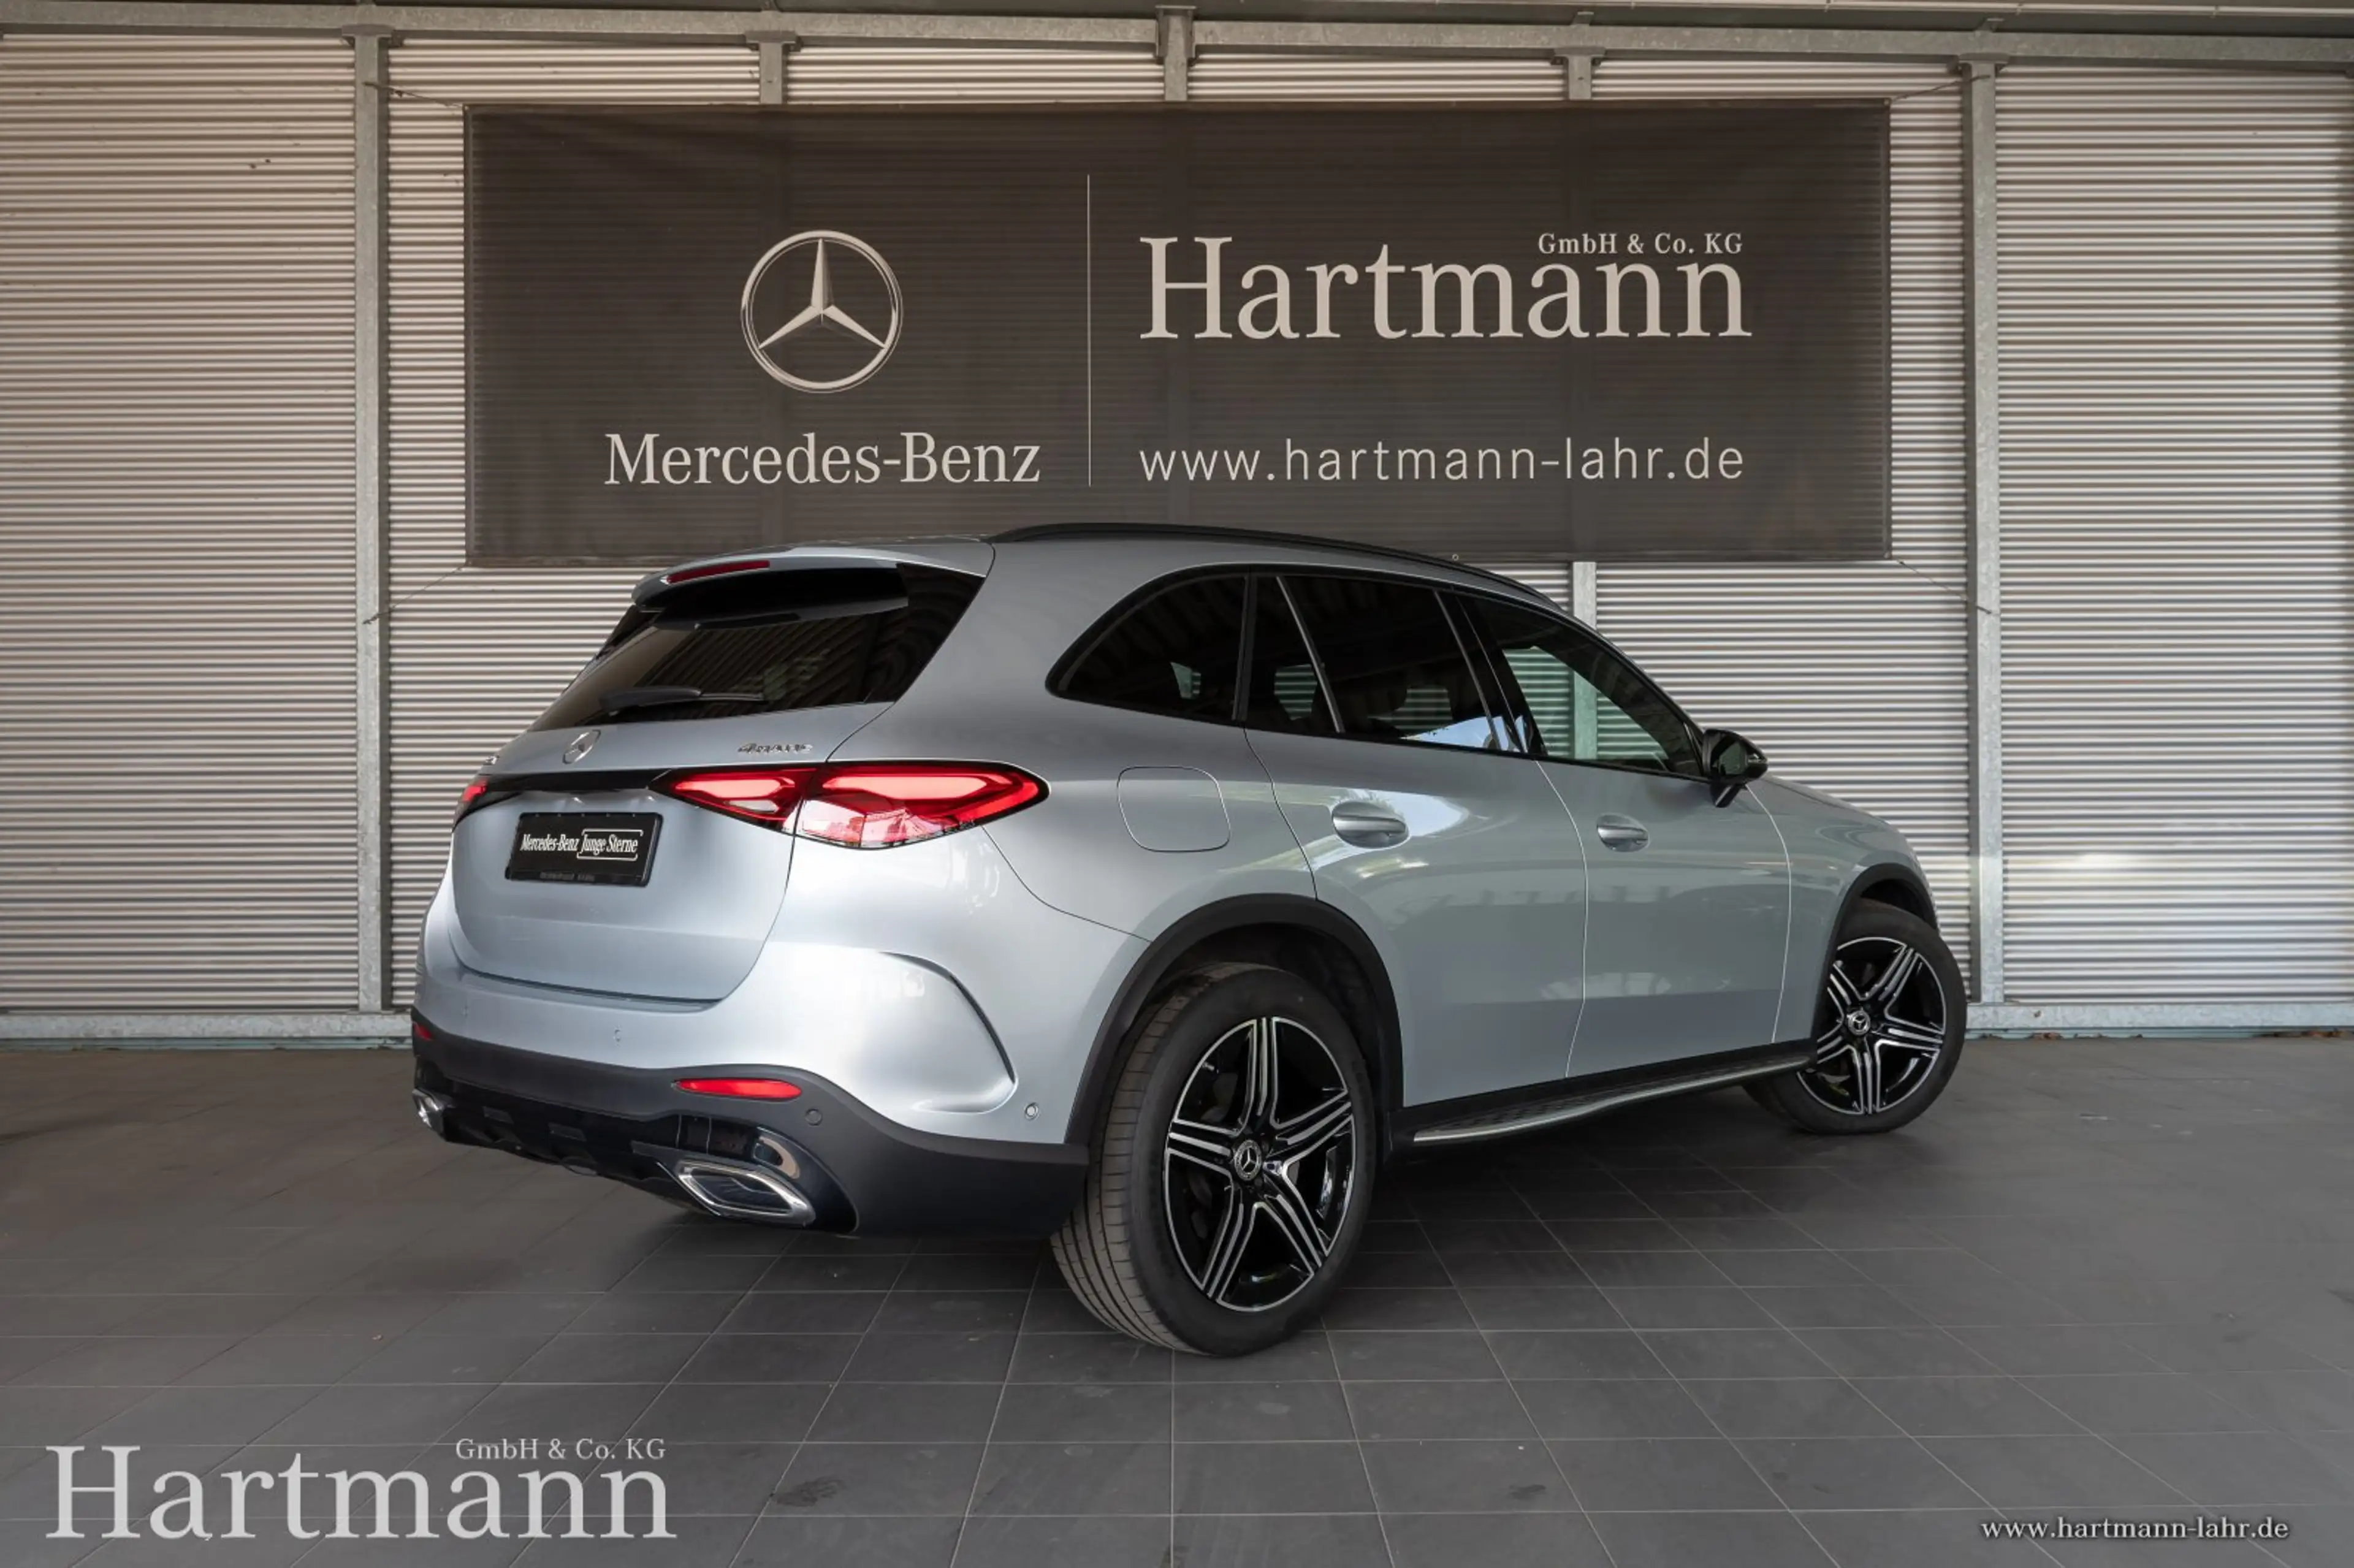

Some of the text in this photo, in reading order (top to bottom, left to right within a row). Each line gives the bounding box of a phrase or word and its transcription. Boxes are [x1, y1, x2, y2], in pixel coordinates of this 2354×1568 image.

[1538, 233, 1742, 254] GmbH & Co. KG
[1140, 237, 1751, 339] Hartmann
[604, 432, 1040, 484] Mercedes-Benz
[1140, 437, 1743, 481] www.hartmann-lahr.de
[520, 834, 638, 855] Mercedes-Benz Junge Sterne
